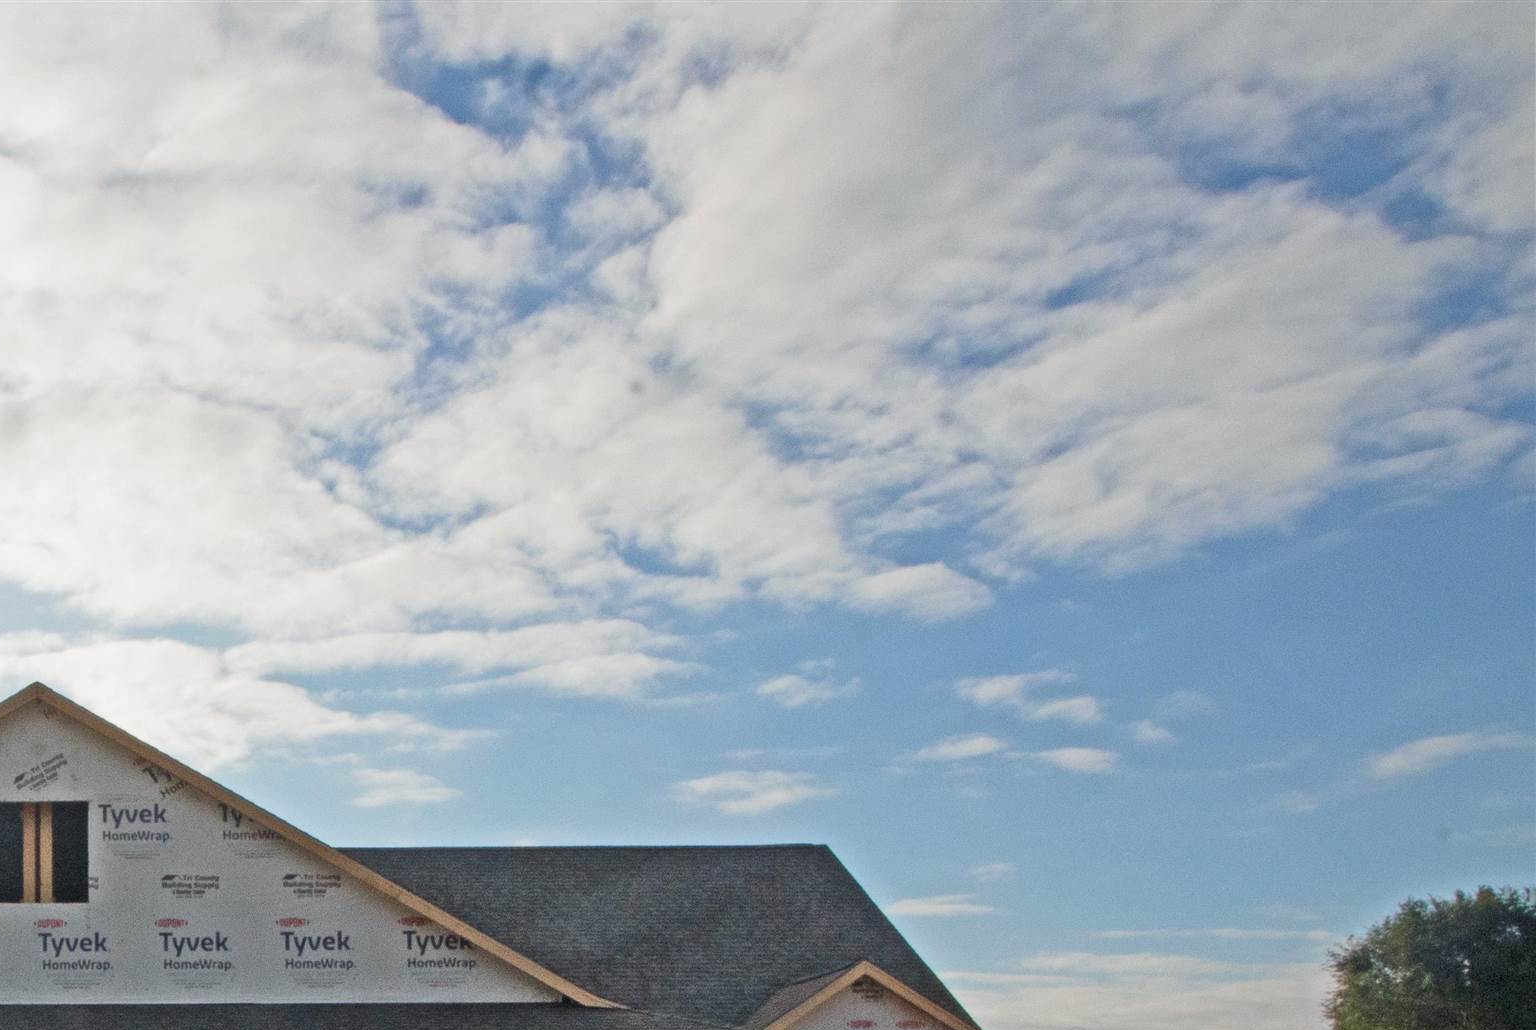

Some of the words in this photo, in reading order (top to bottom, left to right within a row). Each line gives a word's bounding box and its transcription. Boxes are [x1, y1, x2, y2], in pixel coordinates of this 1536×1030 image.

[98, 804, 166, 829] Tyvek
[102, 830, 170, 844] HomeWrap
[36, 918, 65, 929] DUPONT
[38, 932, 107, 957] Tyvek
[159, 931, 228, 957] Tyvek
[280, 931, 350, 956] Tyvek
[42, 959, 111, 972] HomeWrap
[164, 959, 232, 972] HomeWrap
[285, 958, 354, 970] HomeWrap
[407, 958, 476, 970] HomeWrap
